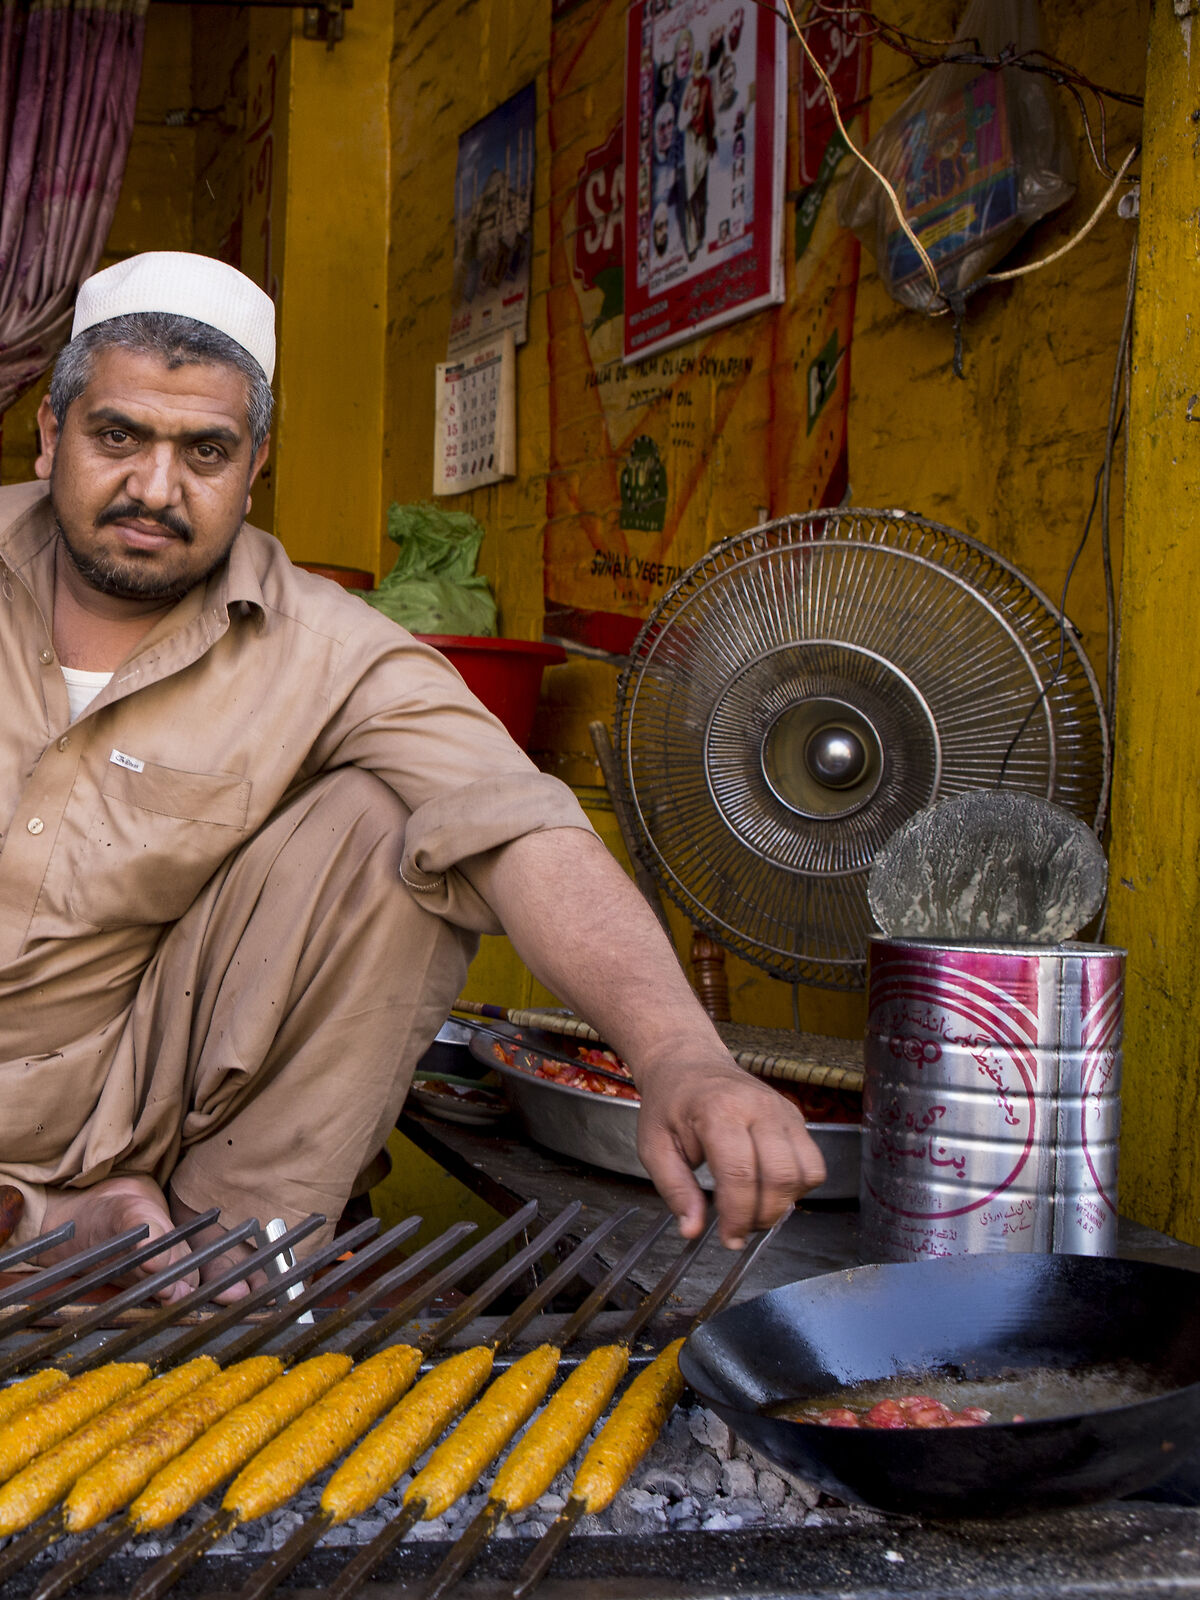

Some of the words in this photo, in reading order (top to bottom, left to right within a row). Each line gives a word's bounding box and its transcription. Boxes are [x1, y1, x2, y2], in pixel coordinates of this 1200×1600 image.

[450, 384, 456, 396] 1
[448, 404, 456, 416] 8
[447, 424, 458, 437] 15
[445, 444, 458, 457] 22
[445, 464, 458, 478] 29
[1075, 1203, 1102, 1230] VITAMINS
